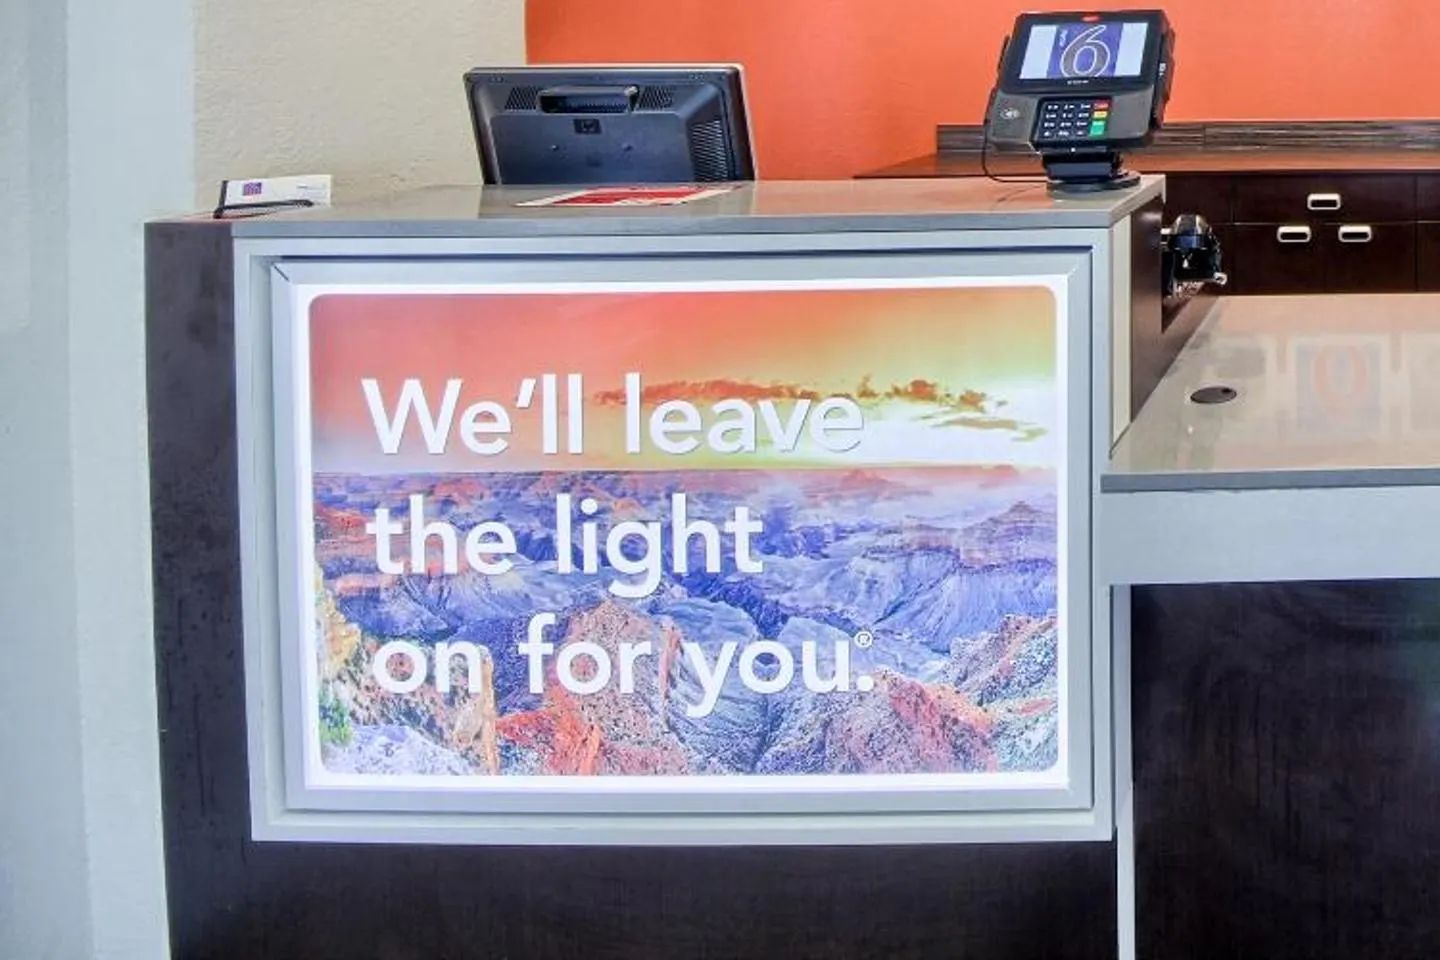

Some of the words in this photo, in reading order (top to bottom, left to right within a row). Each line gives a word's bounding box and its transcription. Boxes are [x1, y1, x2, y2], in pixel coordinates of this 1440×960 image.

[1059, 23, 1111, 78] 6
[361, 373, 583, 455] We'll
[624, 372, 865, 454] leave
[366, 494, 517, 576] the
[556, 492, 764, 598] light
[373, 637, 480, 694] on
[517, 611, 653, 696] for
